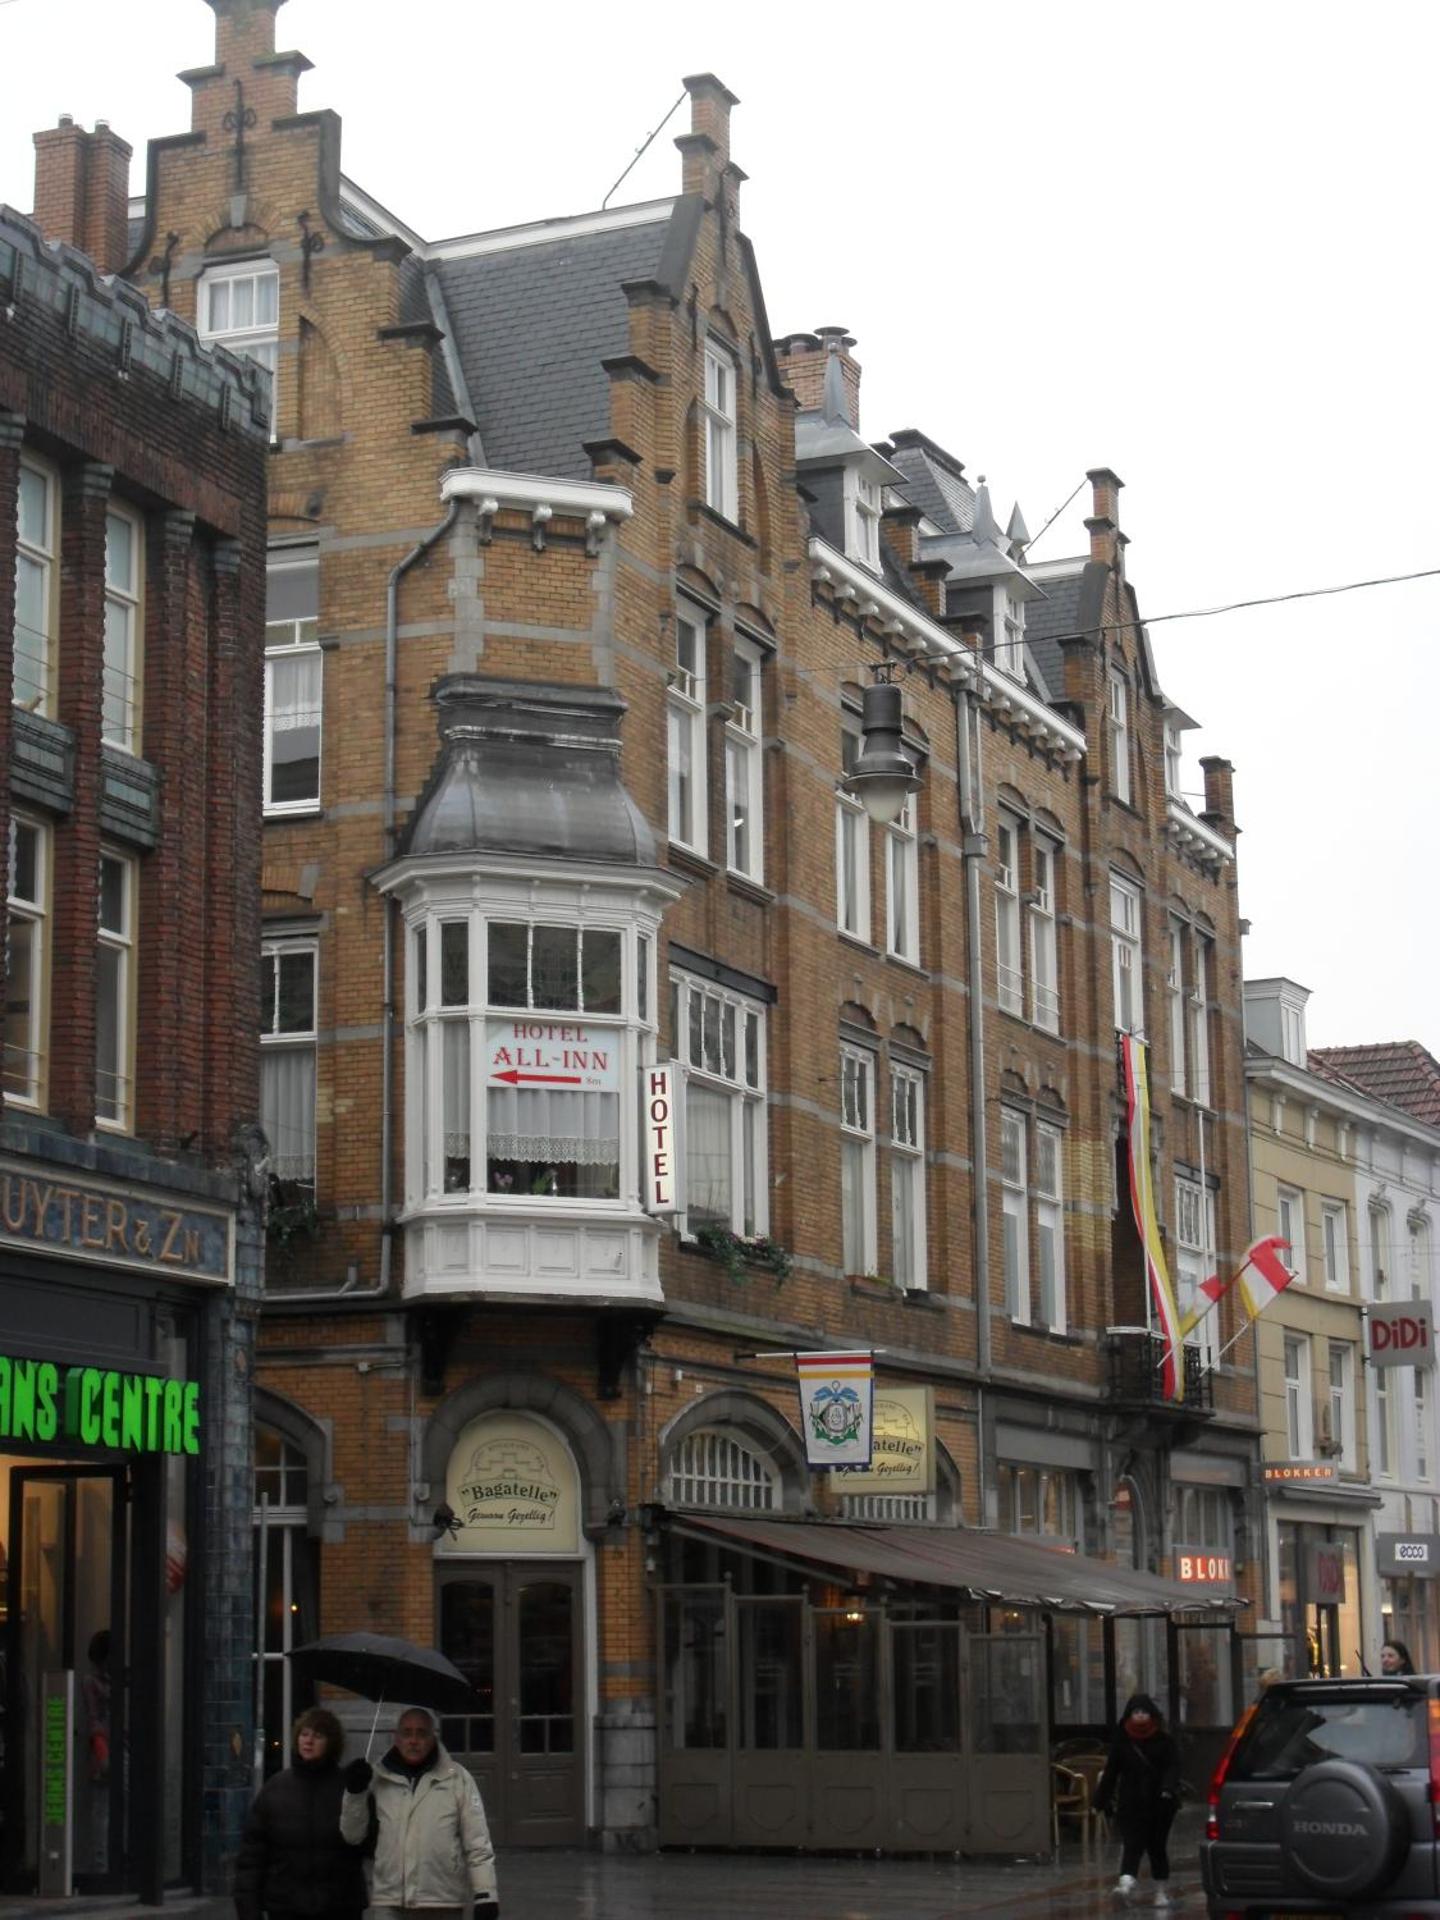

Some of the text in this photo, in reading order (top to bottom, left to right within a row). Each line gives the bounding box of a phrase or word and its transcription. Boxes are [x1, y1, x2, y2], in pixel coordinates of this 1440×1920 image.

[513, 1023, 588, 1042] HOTEL
[493, 1046, 608, 1070] ALL-INN
[650, 1071, 669, 1204] HOTEL
[1371, 1317, 1428, 1351] DiDi
[78, 1366, 200, 1455] CENTRE
[1264, 1467, 1333, 1480] BLOKKER
[1294, 1820, 1368, 1836] HONDA
